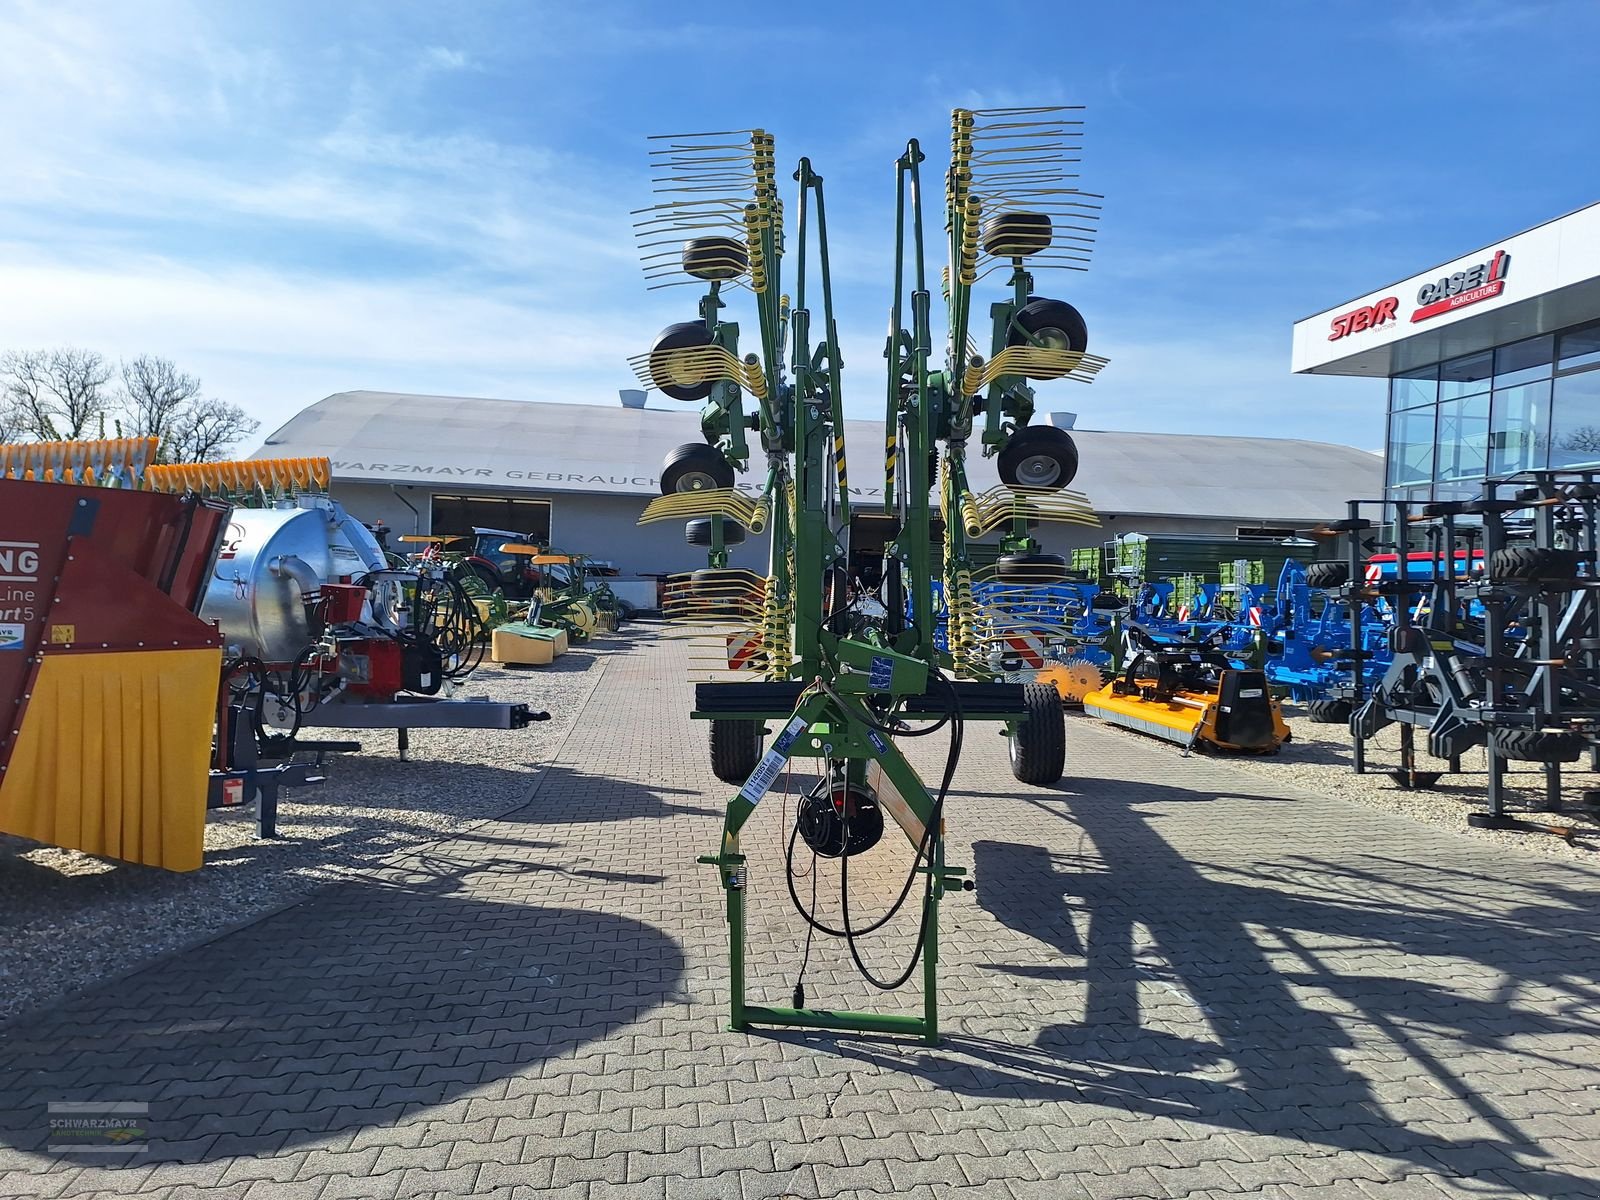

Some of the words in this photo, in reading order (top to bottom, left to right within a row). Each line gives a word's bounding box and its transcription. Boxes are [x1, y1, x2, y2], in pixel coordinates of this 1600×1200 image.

[1416, 263, 1483, 306] CASE
[1450, 283, 1497, 306] AGRICULTURE
[1327, 296, 1399, 341] STEYR
[331, 461, 493, 477] WARZMAYR
[506, 470, 661, 486] GEBRAUCH
